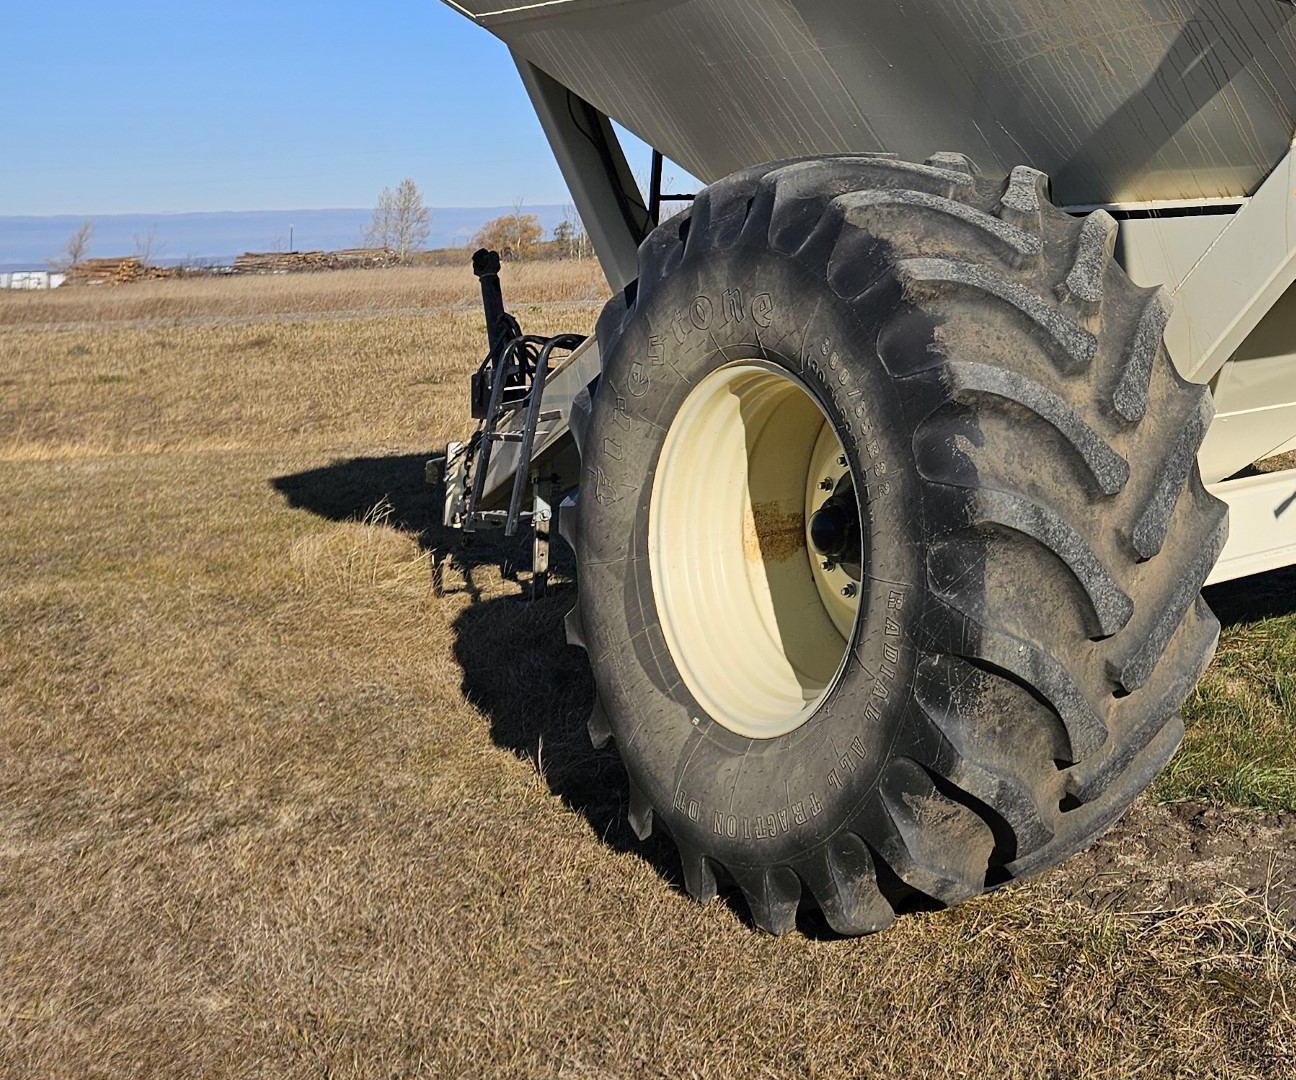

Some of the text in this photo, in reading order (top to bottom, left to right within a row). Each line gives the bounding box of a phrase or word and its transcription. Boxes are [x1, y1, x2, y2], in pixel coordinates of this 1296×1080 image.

[594, 288, 773, 505] Firestone
[674, 590, 906, 840] RADIAL ALL TRACTION DT
